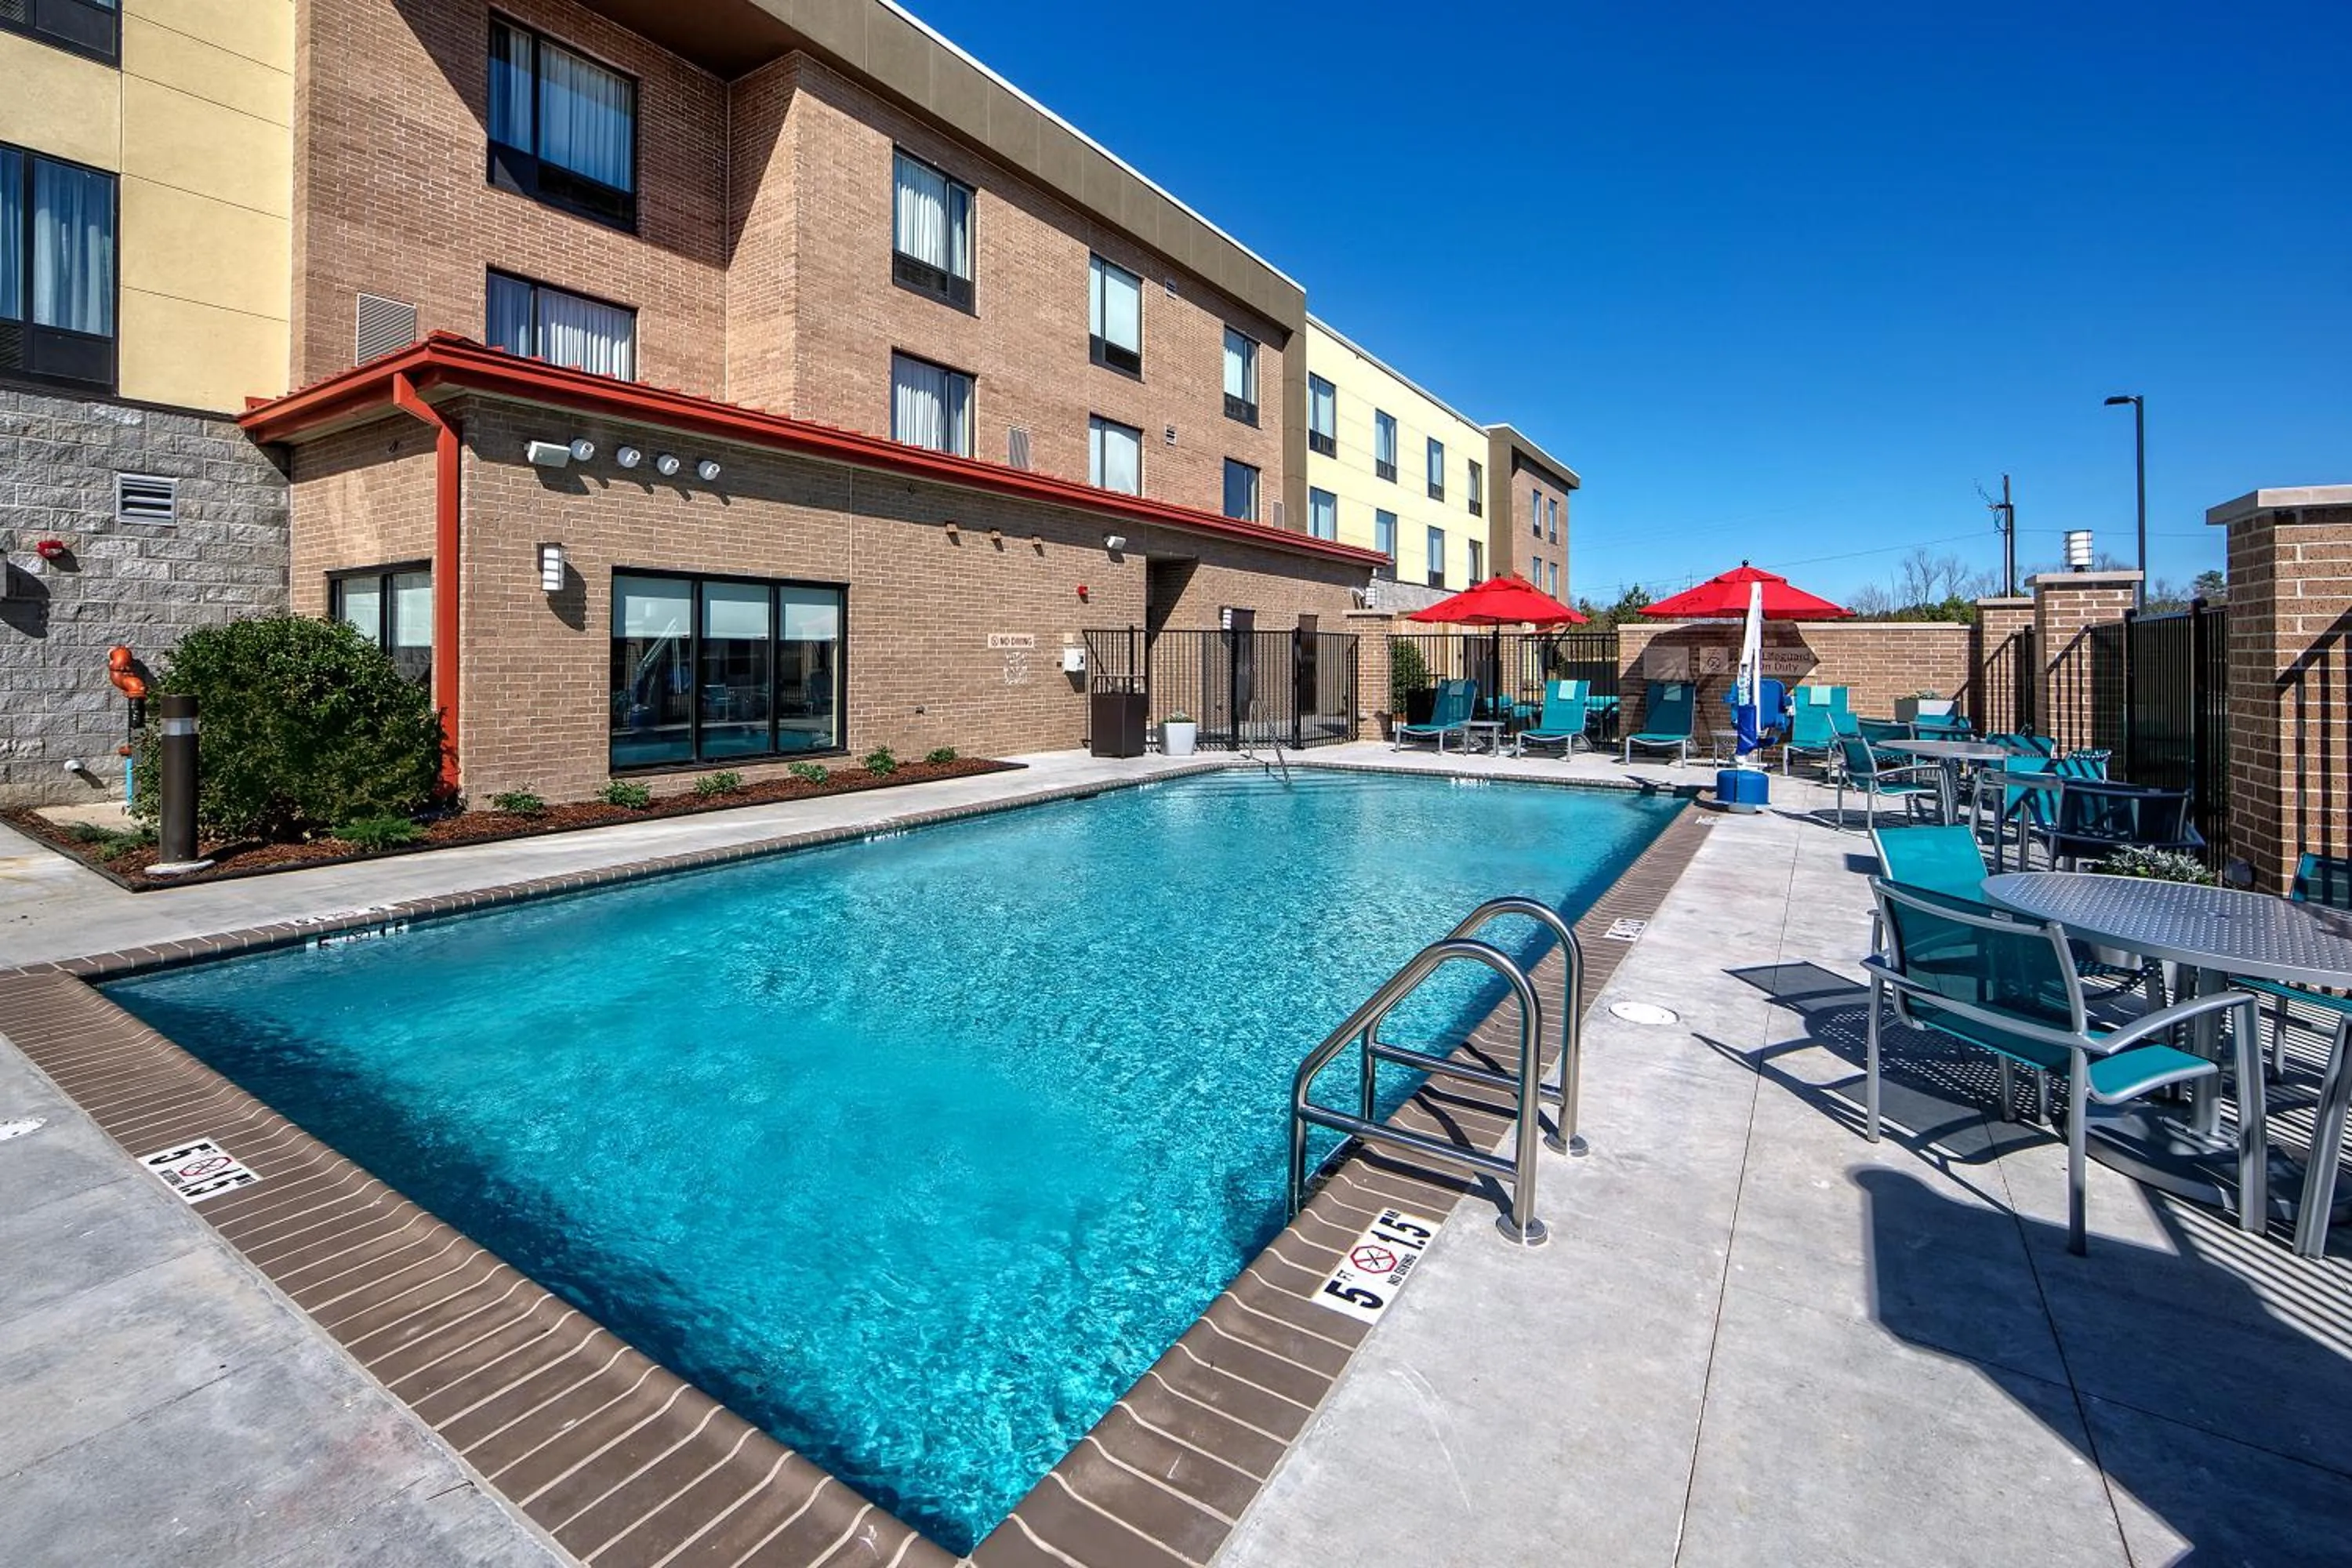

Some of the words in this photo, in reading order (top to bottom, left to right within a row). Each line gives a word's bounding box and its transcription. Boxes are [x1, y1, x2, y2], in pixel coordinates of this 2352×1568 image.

[1000, 637, 1010, 646] NO
[1774, 662, 1798, 673] Duty
[148, 1142, 212, 1165] 5
[1323, 1279, 1384, 1310] 5
[1370, 1216, 1431, 1250] 1.5
